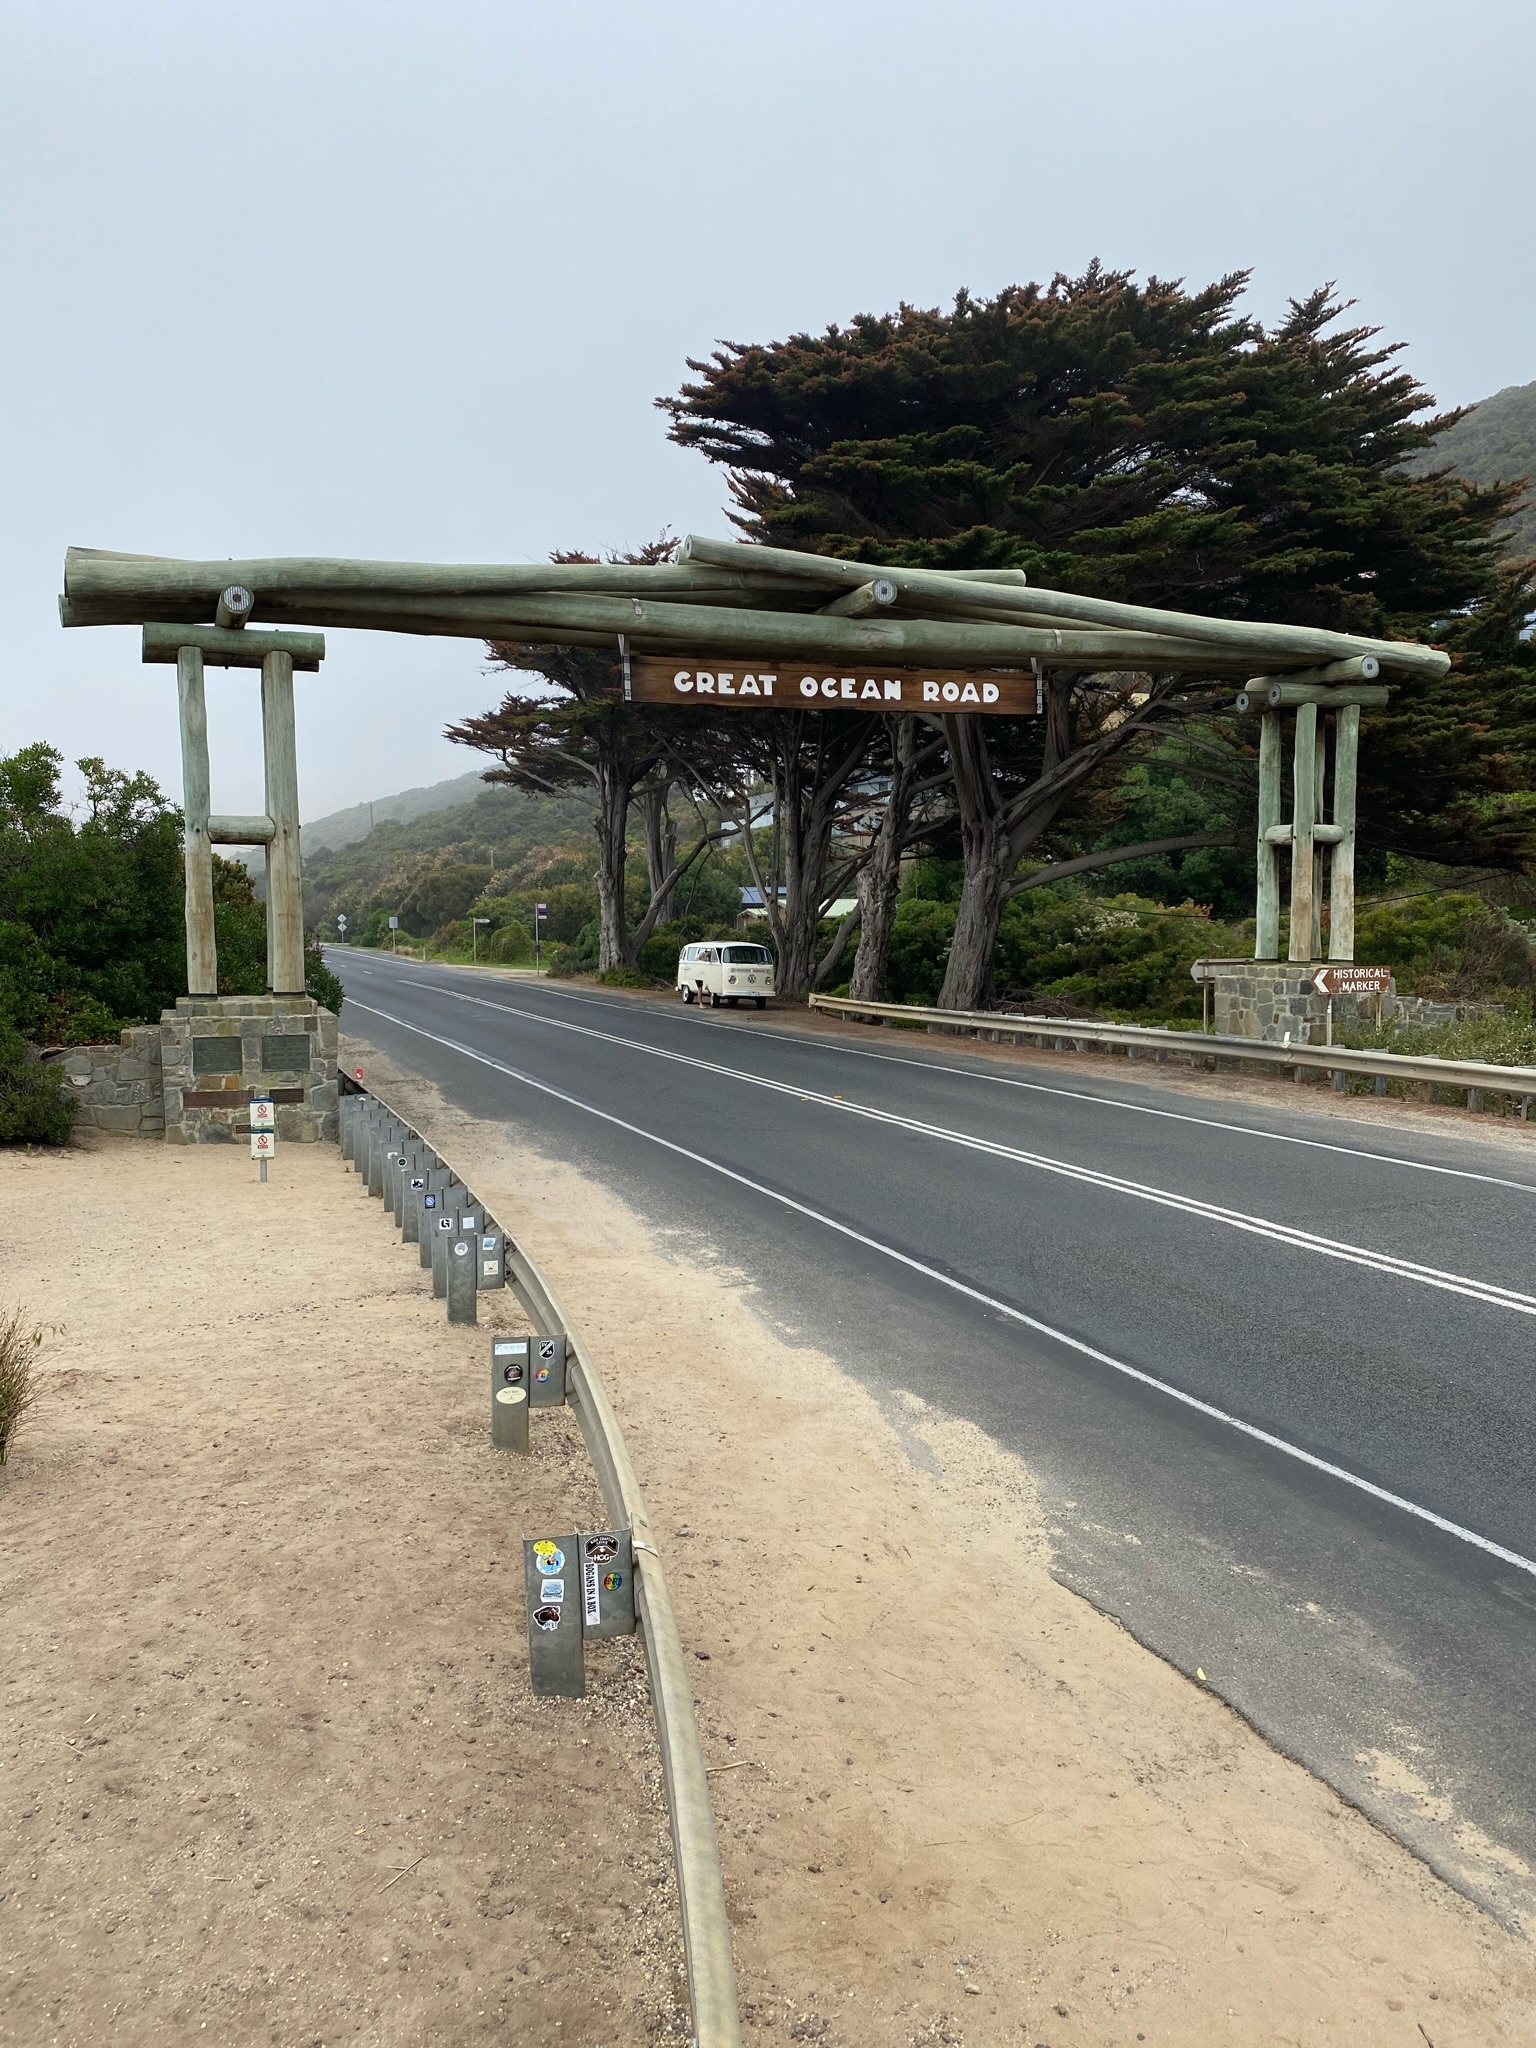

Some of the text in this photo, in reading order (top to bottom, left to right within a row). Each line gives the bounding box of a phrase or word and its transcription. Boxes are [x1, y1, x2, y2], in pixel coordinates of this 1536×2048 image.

[673, 671, 1000, 704] GREAT OCEAN ROAD
[1333, 968, 1387, 979] HISTORICAL
[1342, 981, 1381, 991] MARKER
[594, 1553, 610, 1561] HOG
[586, 1563, 595, 1587] BOGANS
[587, 1601, 596, 1614] BOX
